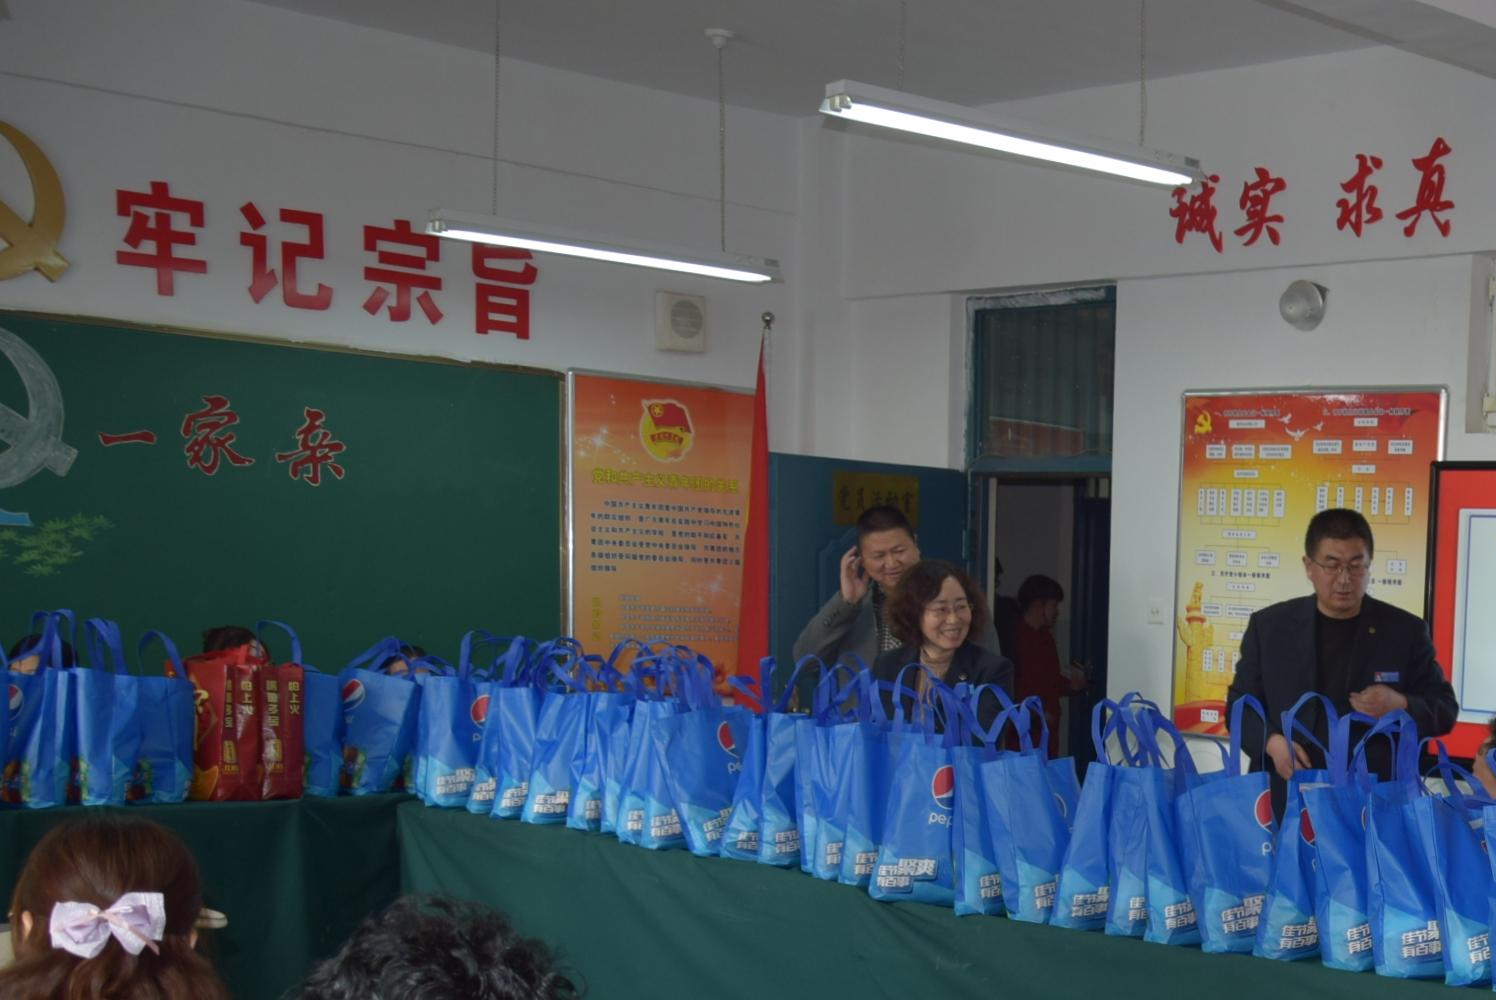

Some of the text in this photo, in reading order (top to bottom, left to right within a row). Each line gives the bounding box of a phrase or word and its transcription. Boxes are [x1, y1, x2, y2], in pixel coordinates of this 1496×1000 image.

[115, 181, 539, 341] 牢记宗旨
[1169, 136, 1456, 253] 诚实 求真
